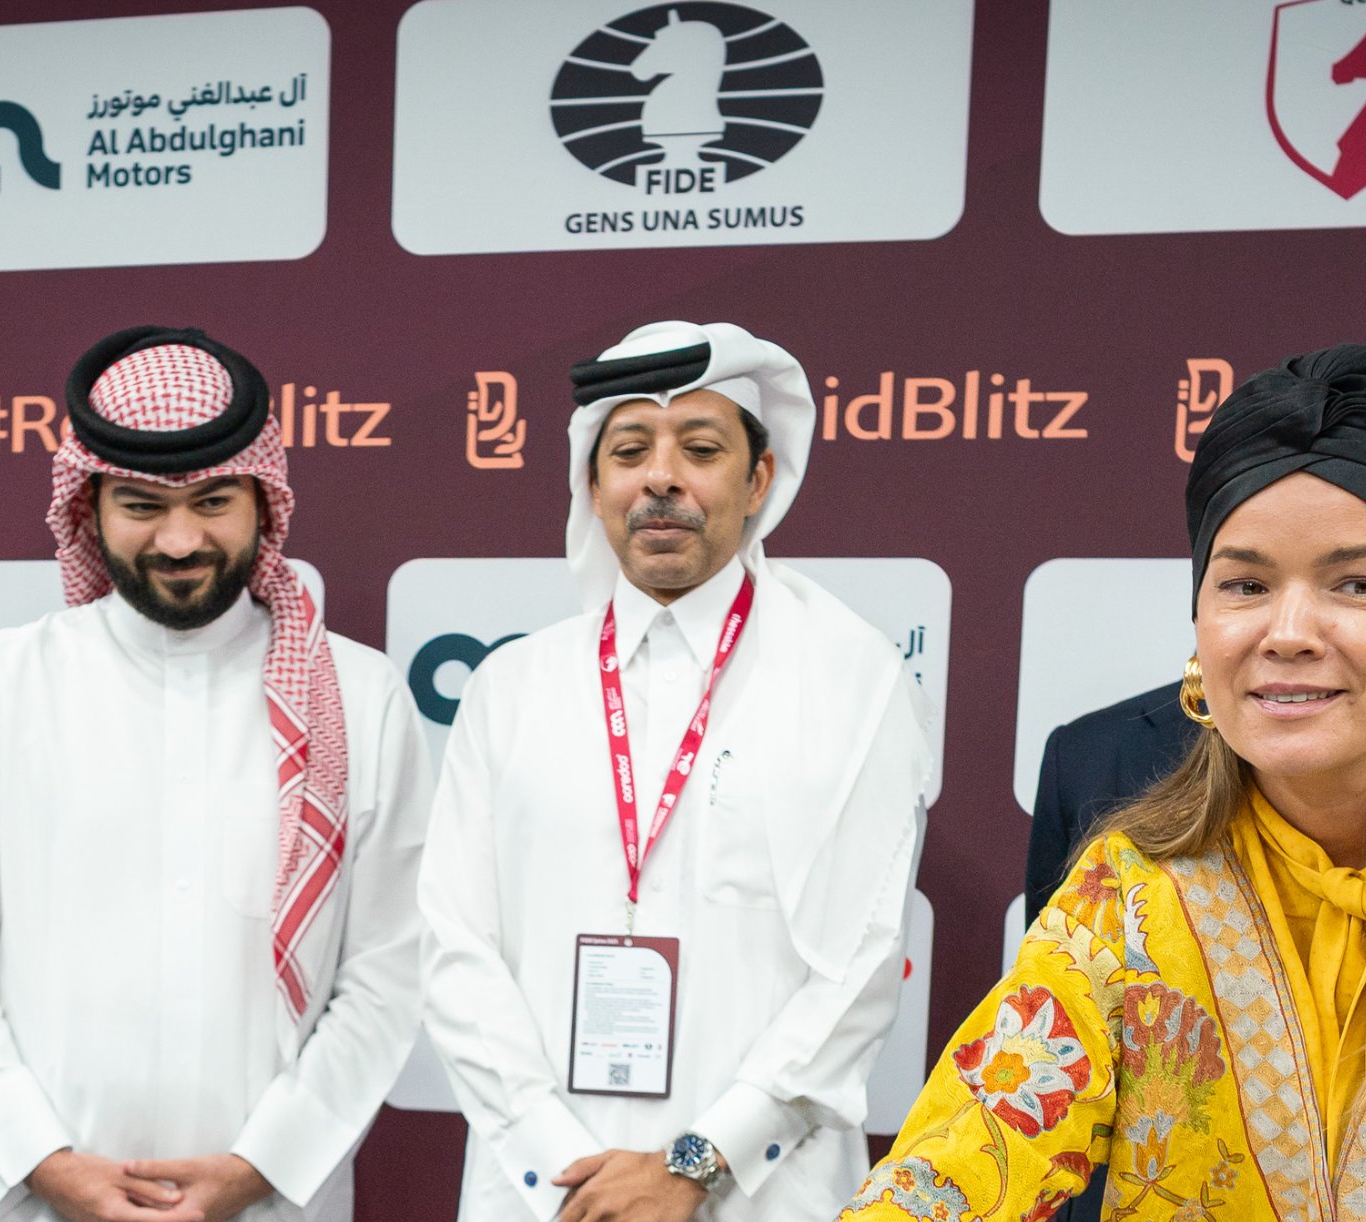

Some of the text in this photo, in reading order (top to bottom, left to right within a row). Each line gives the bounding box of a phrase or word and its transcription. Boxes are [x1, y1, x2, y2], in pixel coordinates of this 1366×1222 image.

[87, 73, 308, 122] آل عبدالغني موتورز
[87, 118, 306, 157] Al Abdulghani
[86, 162, 192, 189] Motors
[646, 167, 716, 195] FIDE
[564, 205, 804, 235] GENS UNA SUMUS
[823, 369, 1089, 442] idBlitz
